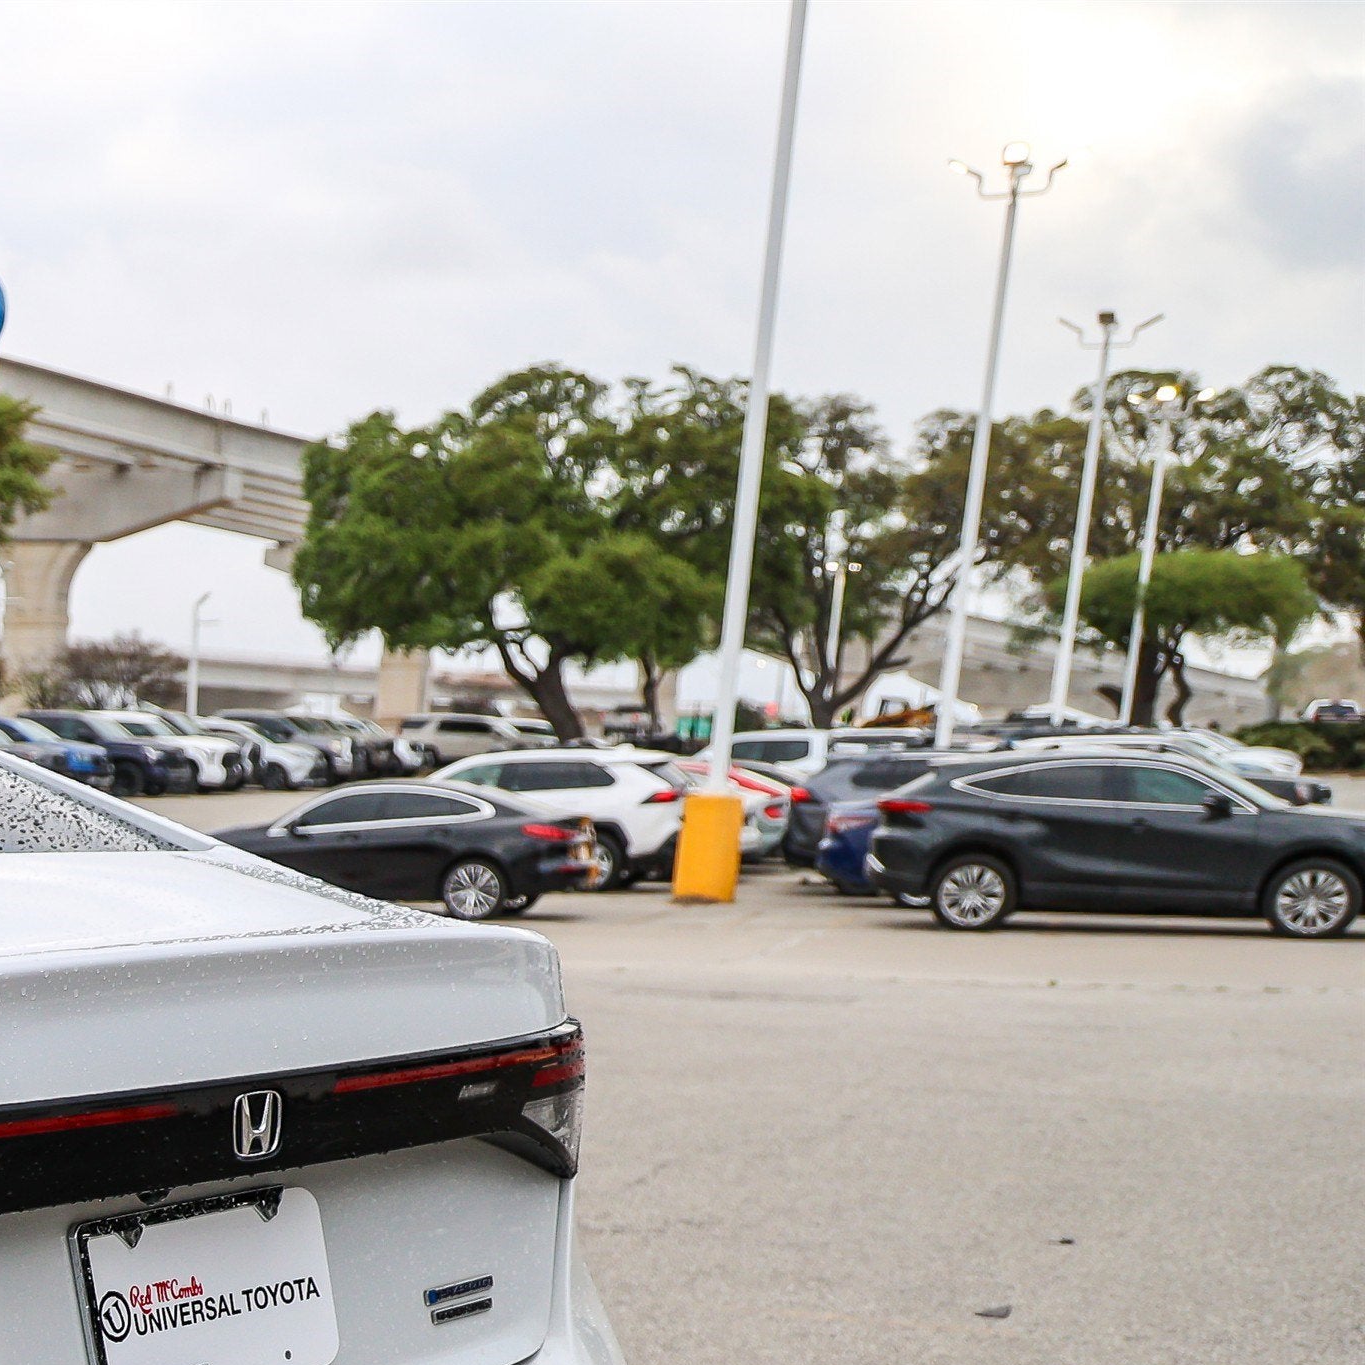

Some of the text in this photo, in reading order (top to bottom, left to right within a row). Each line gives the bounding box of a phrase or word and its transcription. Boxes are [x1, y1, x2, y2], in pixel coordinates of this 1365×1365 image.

[130, 1275, 204, 1315] Red McCombs
[133, 1276, 321, 1336] UNIVERSAL TOYOTA
